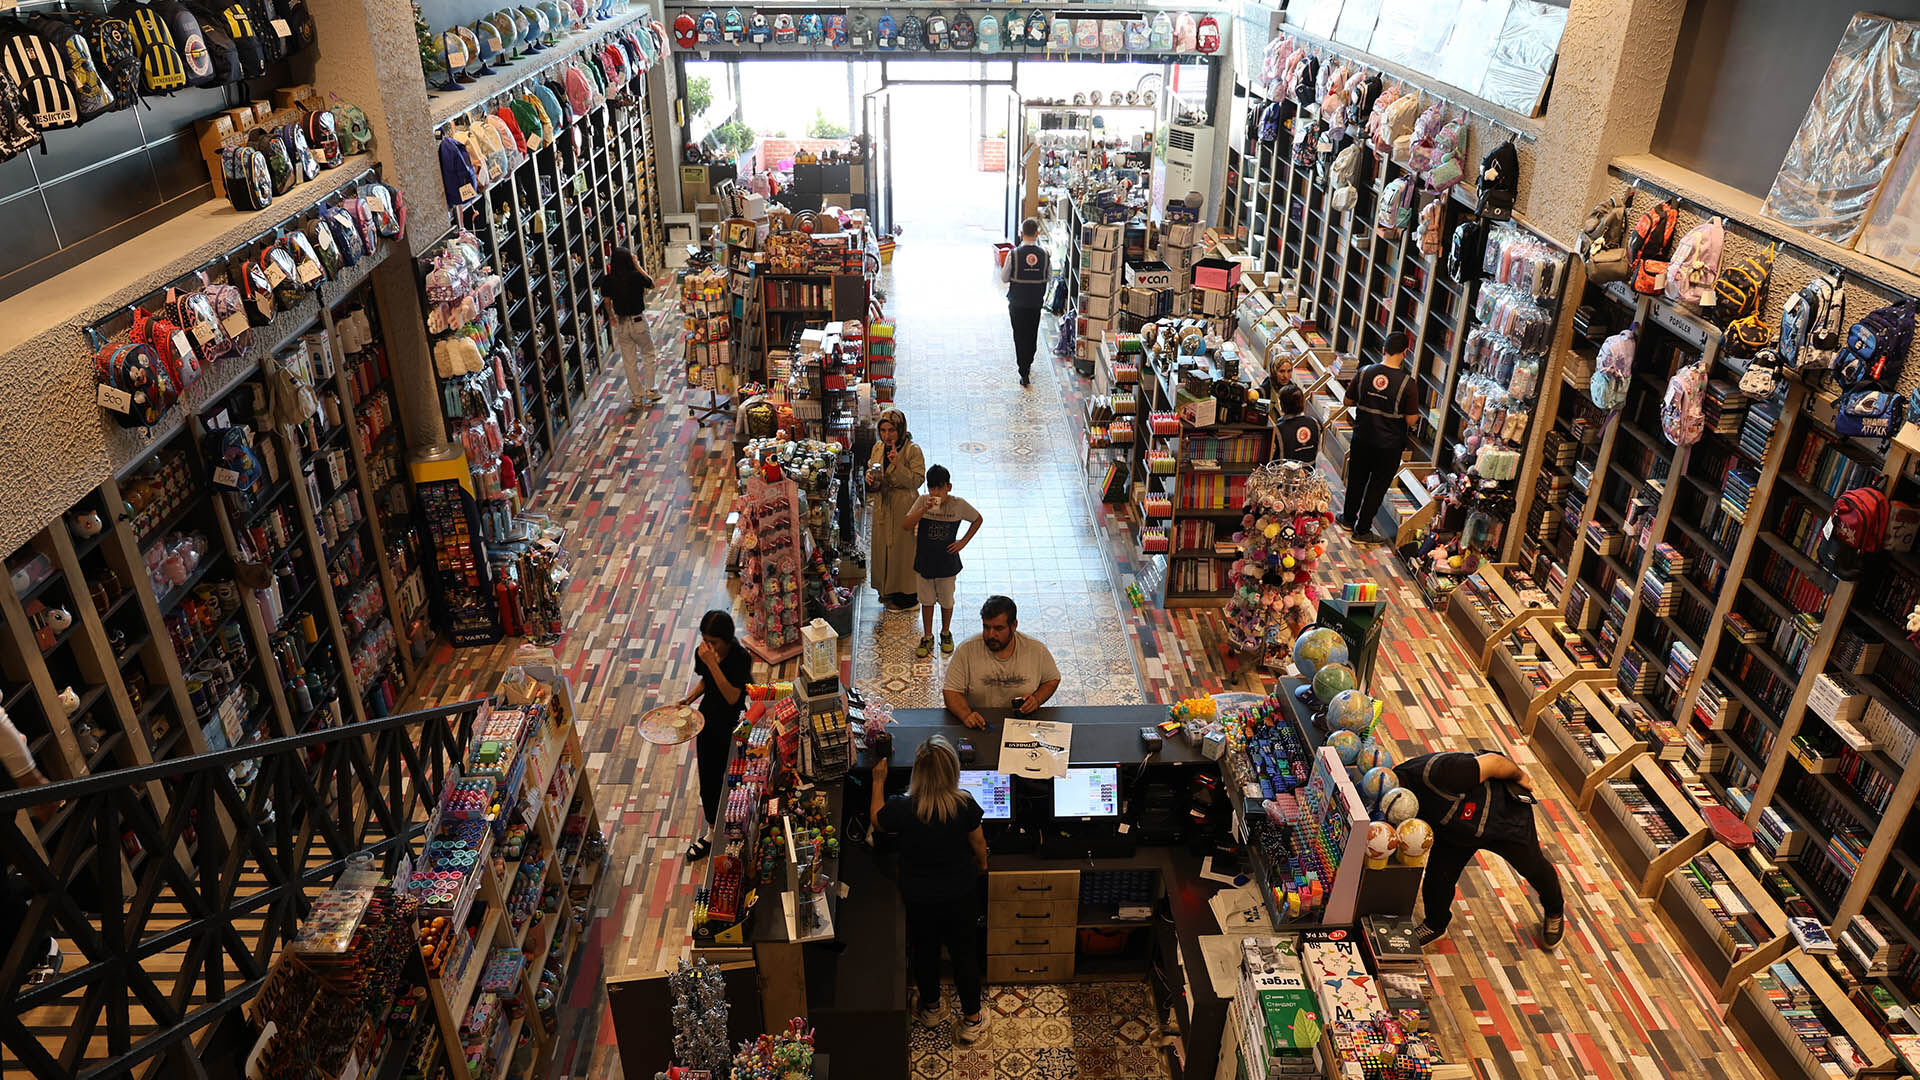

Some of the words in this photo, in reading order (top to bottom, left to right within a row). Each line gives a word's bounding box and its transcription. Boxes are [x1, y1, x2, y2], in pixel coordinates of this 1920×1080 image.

[1146, 274, 1169, 284] can
[1861, 417, 1889, 428] SHARK
[1860, 426, 1888, 436] ATTACK
[464, 633, 491, 641] VARTA
[1334, 942, 1353, 956] A4
[1261, 976, 1301, 986] target
[1335, 1005, 1355, 1021] A4
